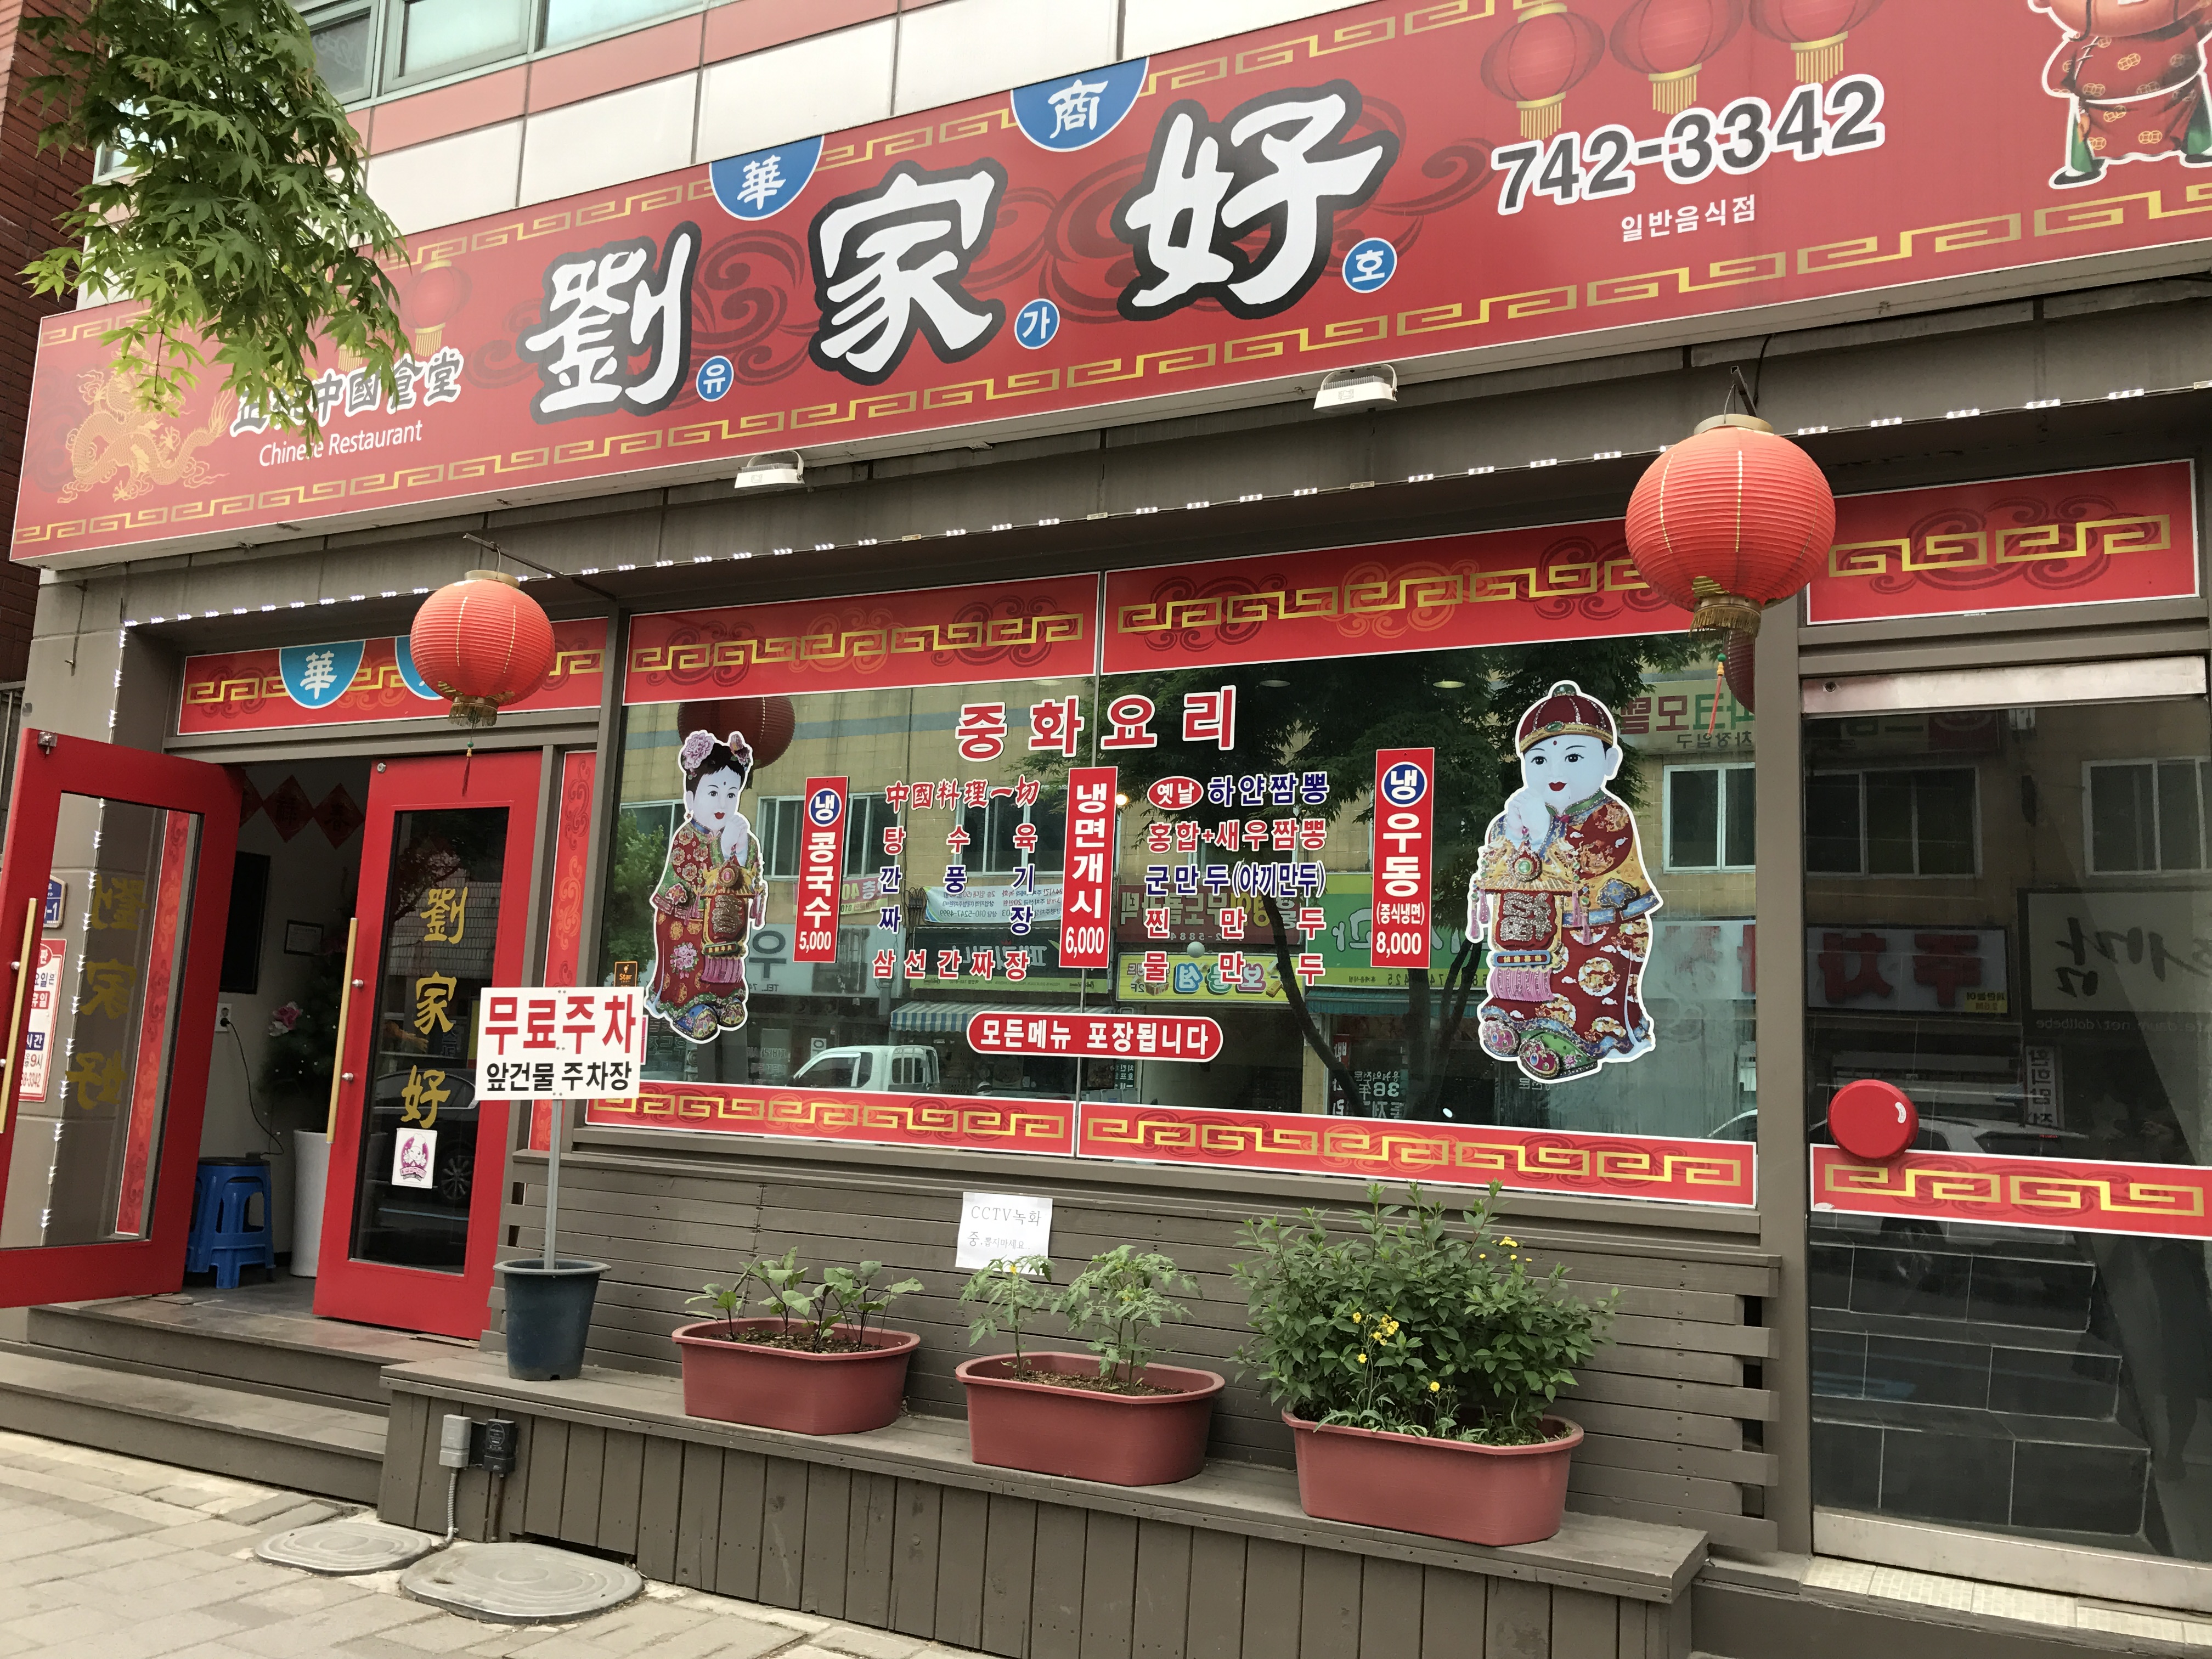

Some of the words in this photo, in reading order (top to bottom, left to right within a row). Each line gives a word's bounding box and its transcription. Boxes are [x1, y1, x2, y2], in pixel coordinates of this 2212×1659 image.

[737, 154, 786, 210] 華
[1048, 79, 1109, 139] 商
[1491, 74, 1886, 216] 742-3342
[1621, 194, 1757, 243] 일반음식점
[328, 419, 423, 456] Restaurant
[300, 650, 337, 700] 華
[1156, 781, 1195, 806] 옛날
[1207, 771, 1330, 808] 하얀짬뽕
[1375, 900, 1426, 926] (중식냉면)
[798, 931, 832, 954] 5,000
[1065, 926, 1104, 960] 6,000
[1375, 932, 1422, 959] 8,000
[485, 993, 636, 1056] 무료주차
[980, 1018, 1072, 1051] 모든메뉴
[1086, 1020, 1209, 1056] 포장됩니다
[486, 1062, 555, 1092] 앞건물
[561, 1060, 632, 1091] 주차장
